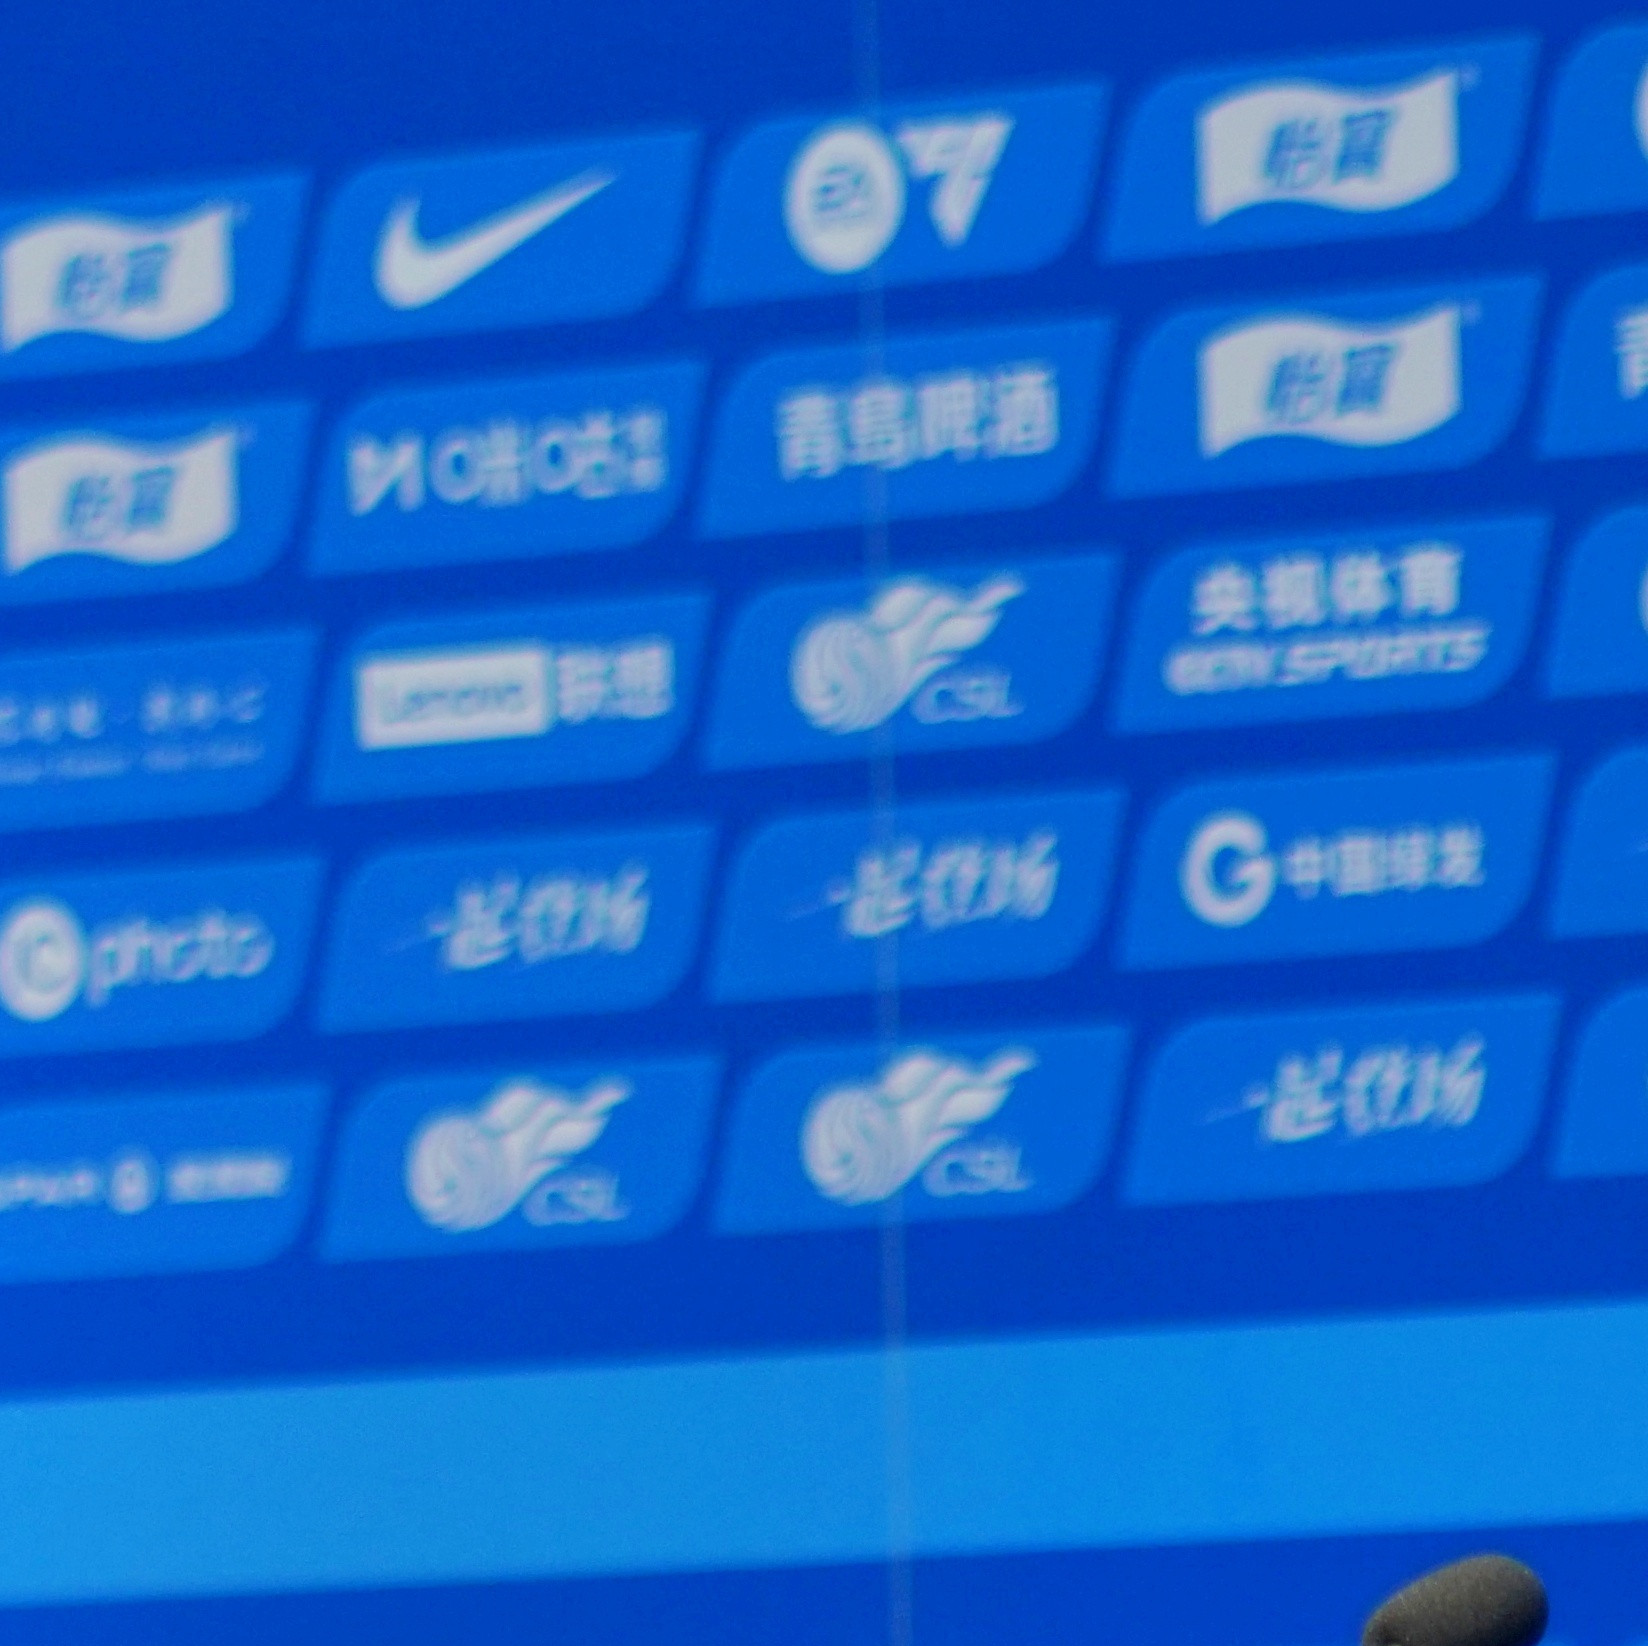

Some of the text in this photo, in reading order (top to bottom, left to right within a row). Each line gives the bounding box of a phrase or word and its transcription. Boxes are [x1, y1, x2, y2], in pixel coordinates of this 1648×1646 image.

[909, 665, 1027, 724] CSL
[521, 1168, 632, 1228] CSL
[919, 1139, 1034, 1199] CSL
